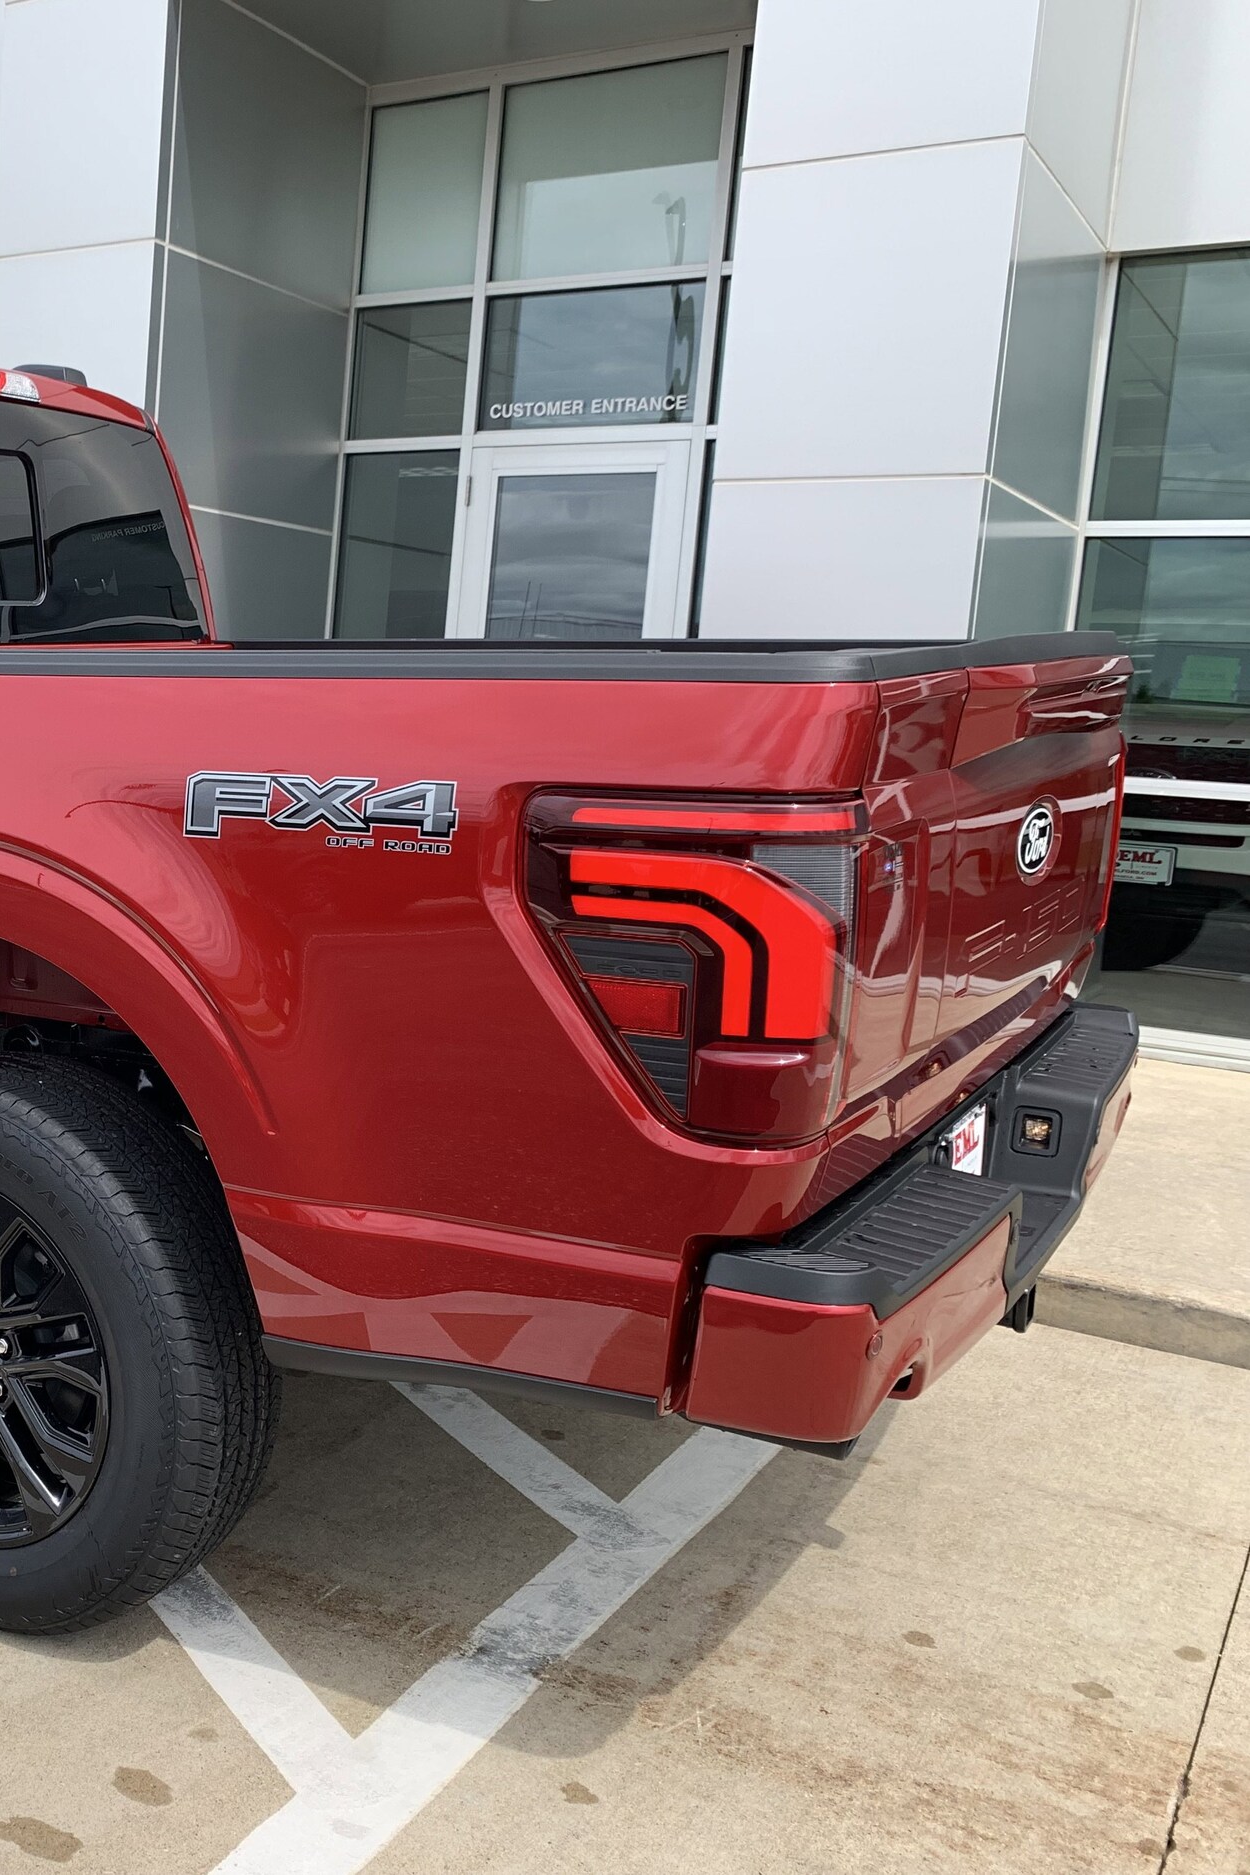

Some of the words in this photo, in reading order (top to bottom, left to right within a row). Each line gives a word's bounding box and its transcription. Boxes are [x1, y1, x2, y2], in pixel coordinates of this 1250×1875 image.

[489, 401, 583, 419] CUSTOMER
[590, 394, 688, 414] ENTRANCE
[183, 770, 459, 840] FX4
[325, 836, 375, 850] OFF
[383, 839, 452, 855] ROAD
[1022, 815, 1052, 867] Ford
[1116, 849, 1163, 865] EML
[954, 1119, 980, 1167] EML
